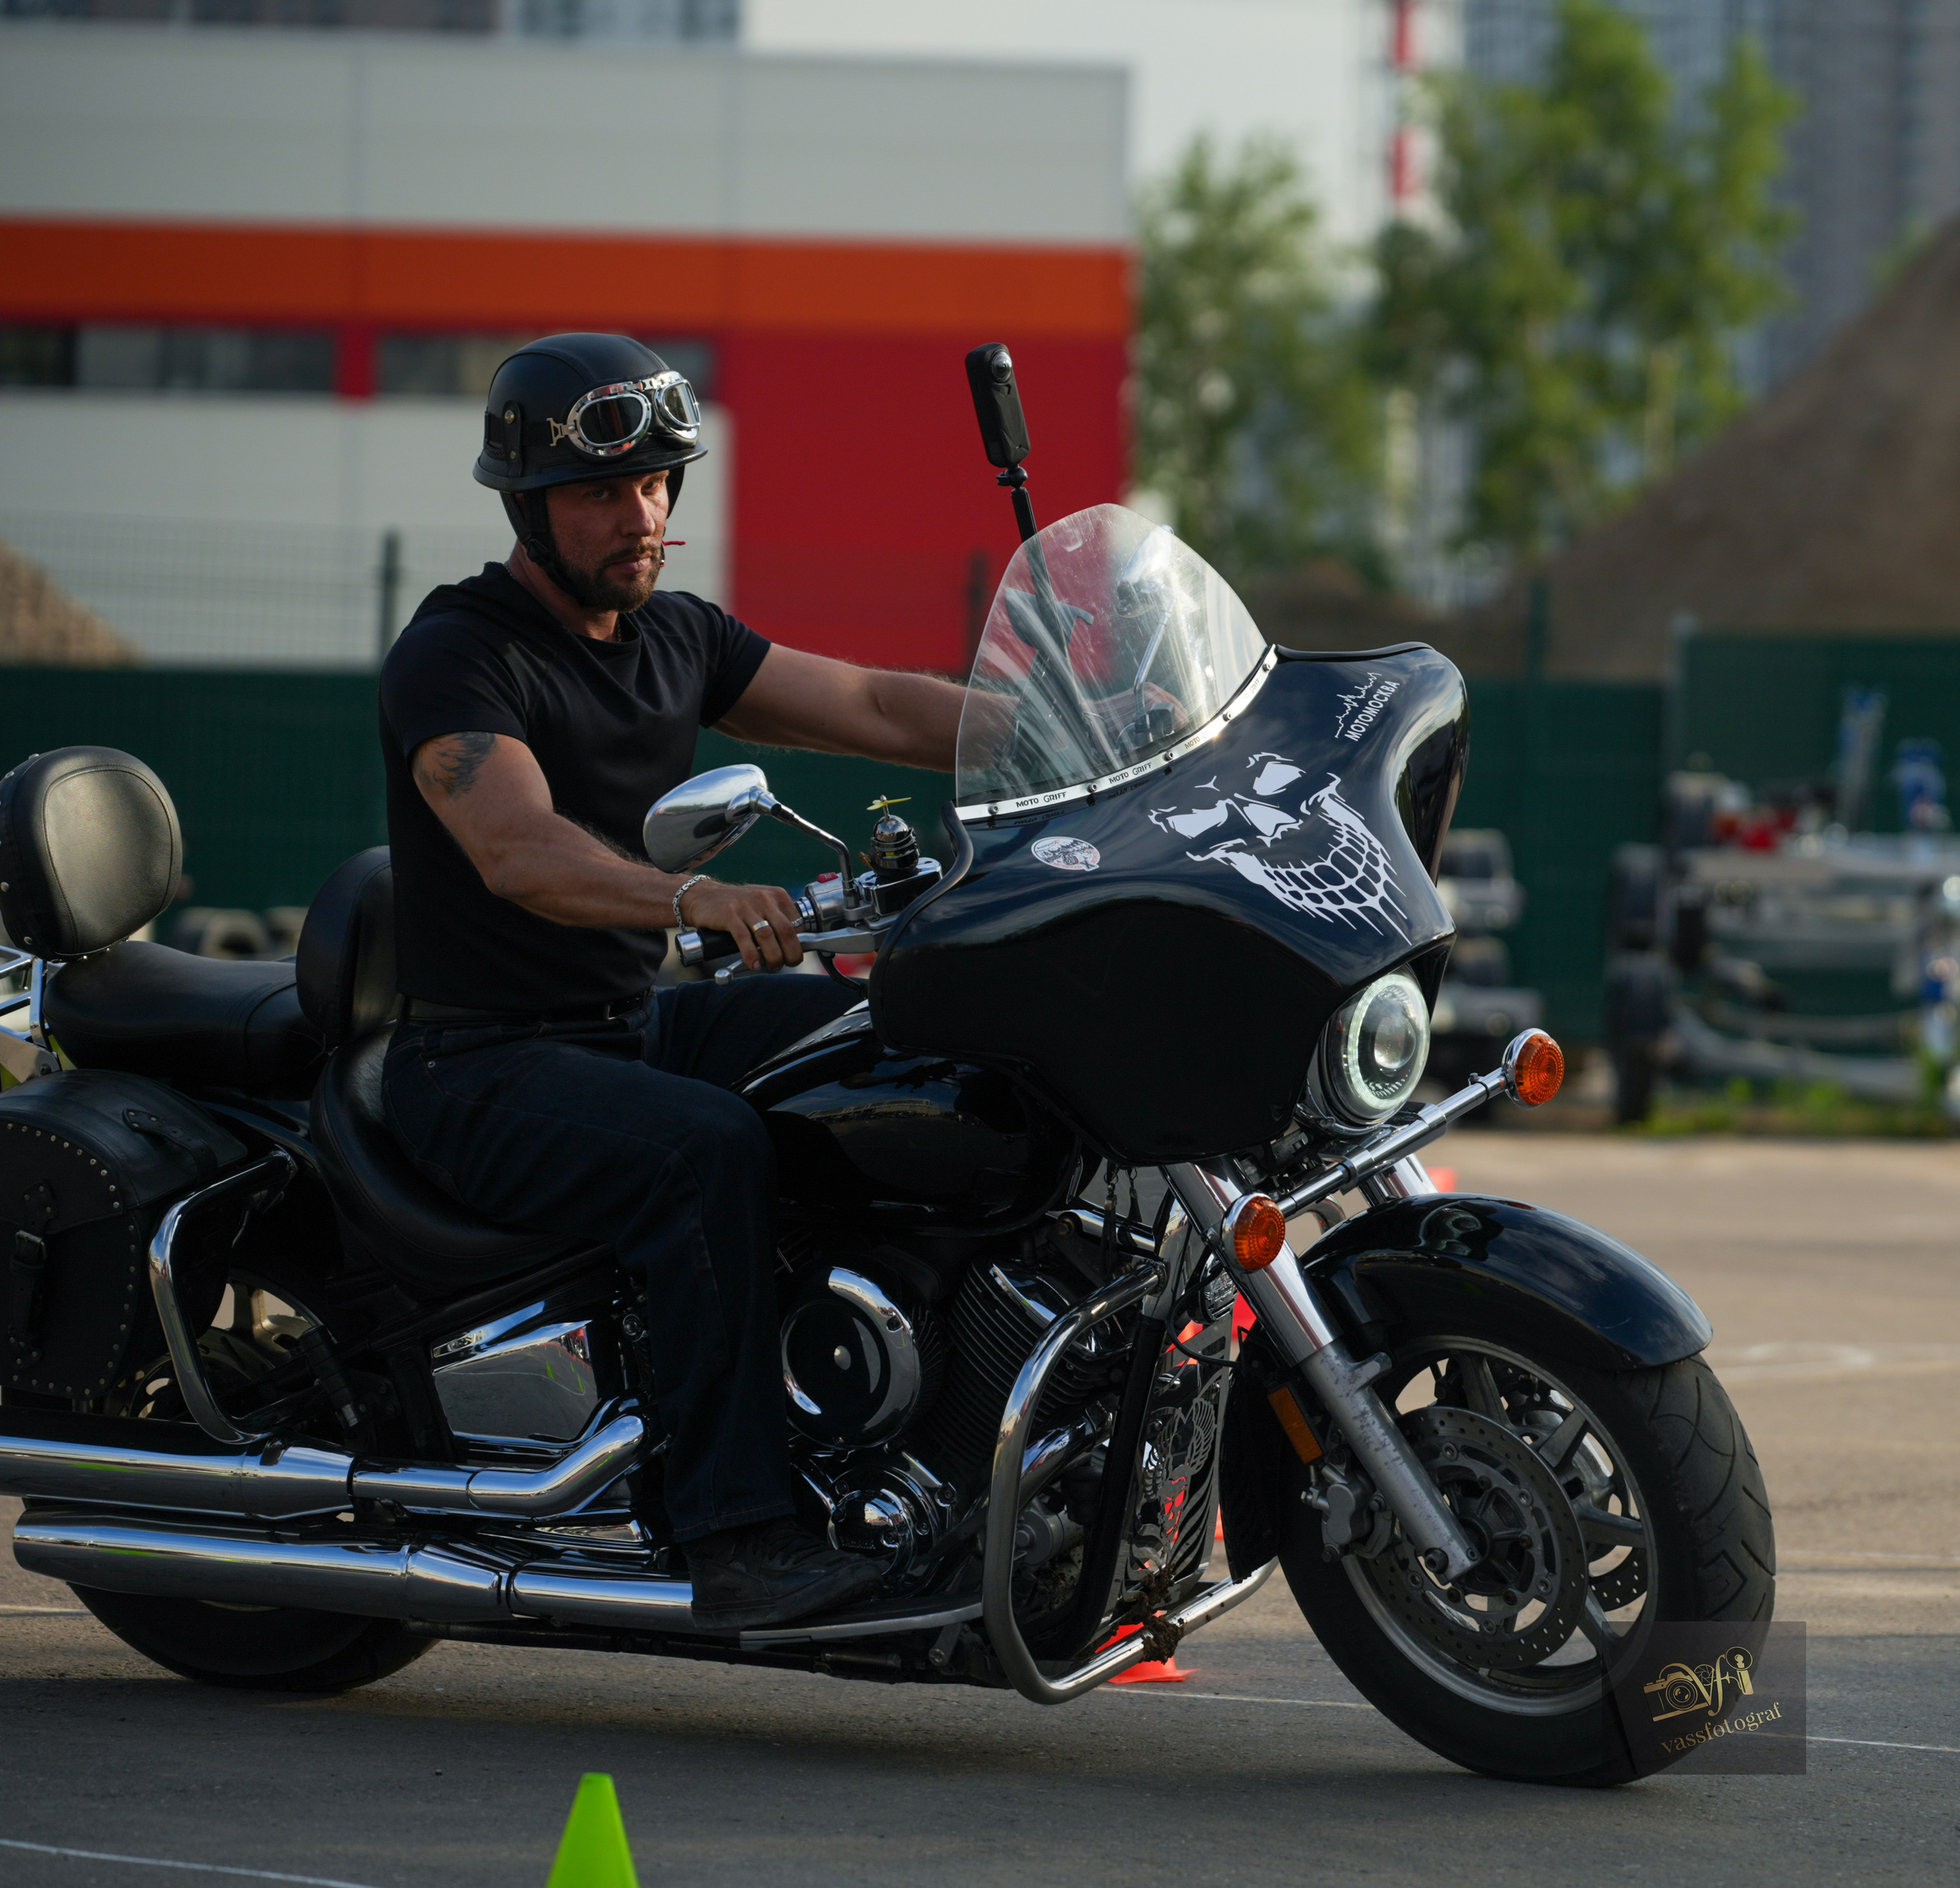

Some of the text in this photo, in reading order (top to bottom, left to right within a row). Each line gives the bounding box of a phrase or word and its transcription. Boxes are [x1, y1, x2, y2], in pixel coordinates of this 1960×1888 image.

[1344, 681, 1400, 742] МОТОМОСКВА
[1184, 737, 1200, 750] MOTO
[1109, 762, 1152, 784] MOTO GRIFF
[1015, 792, 1067, 808] MOTO GRIFF
